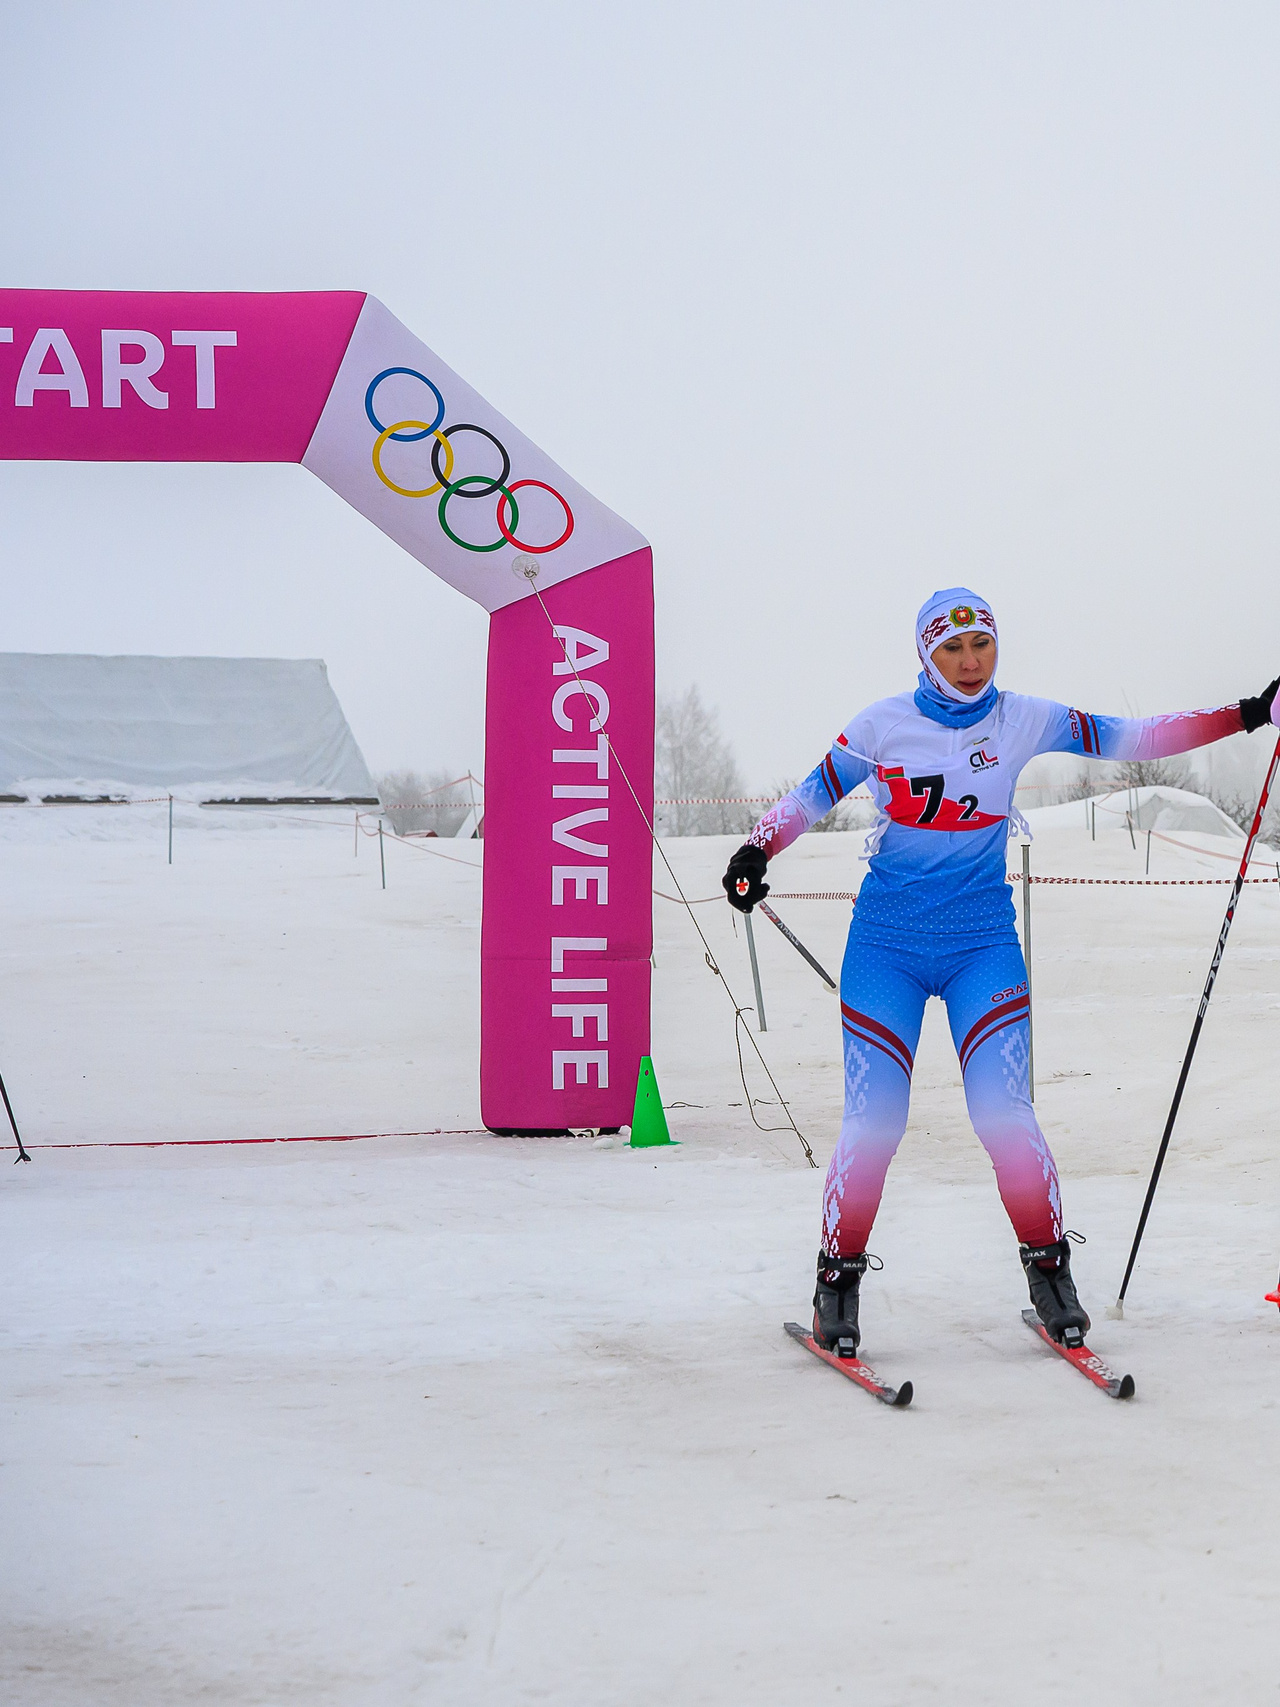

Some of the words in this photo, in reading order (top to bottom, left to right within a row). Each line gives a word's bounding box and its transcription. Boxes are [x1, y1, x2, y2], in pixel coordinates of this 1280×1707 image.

[0, 327, 238, 410] ART
[551, 623, 610, 906] ACTIVE
[551, 937, 609, 1091] LIFE
